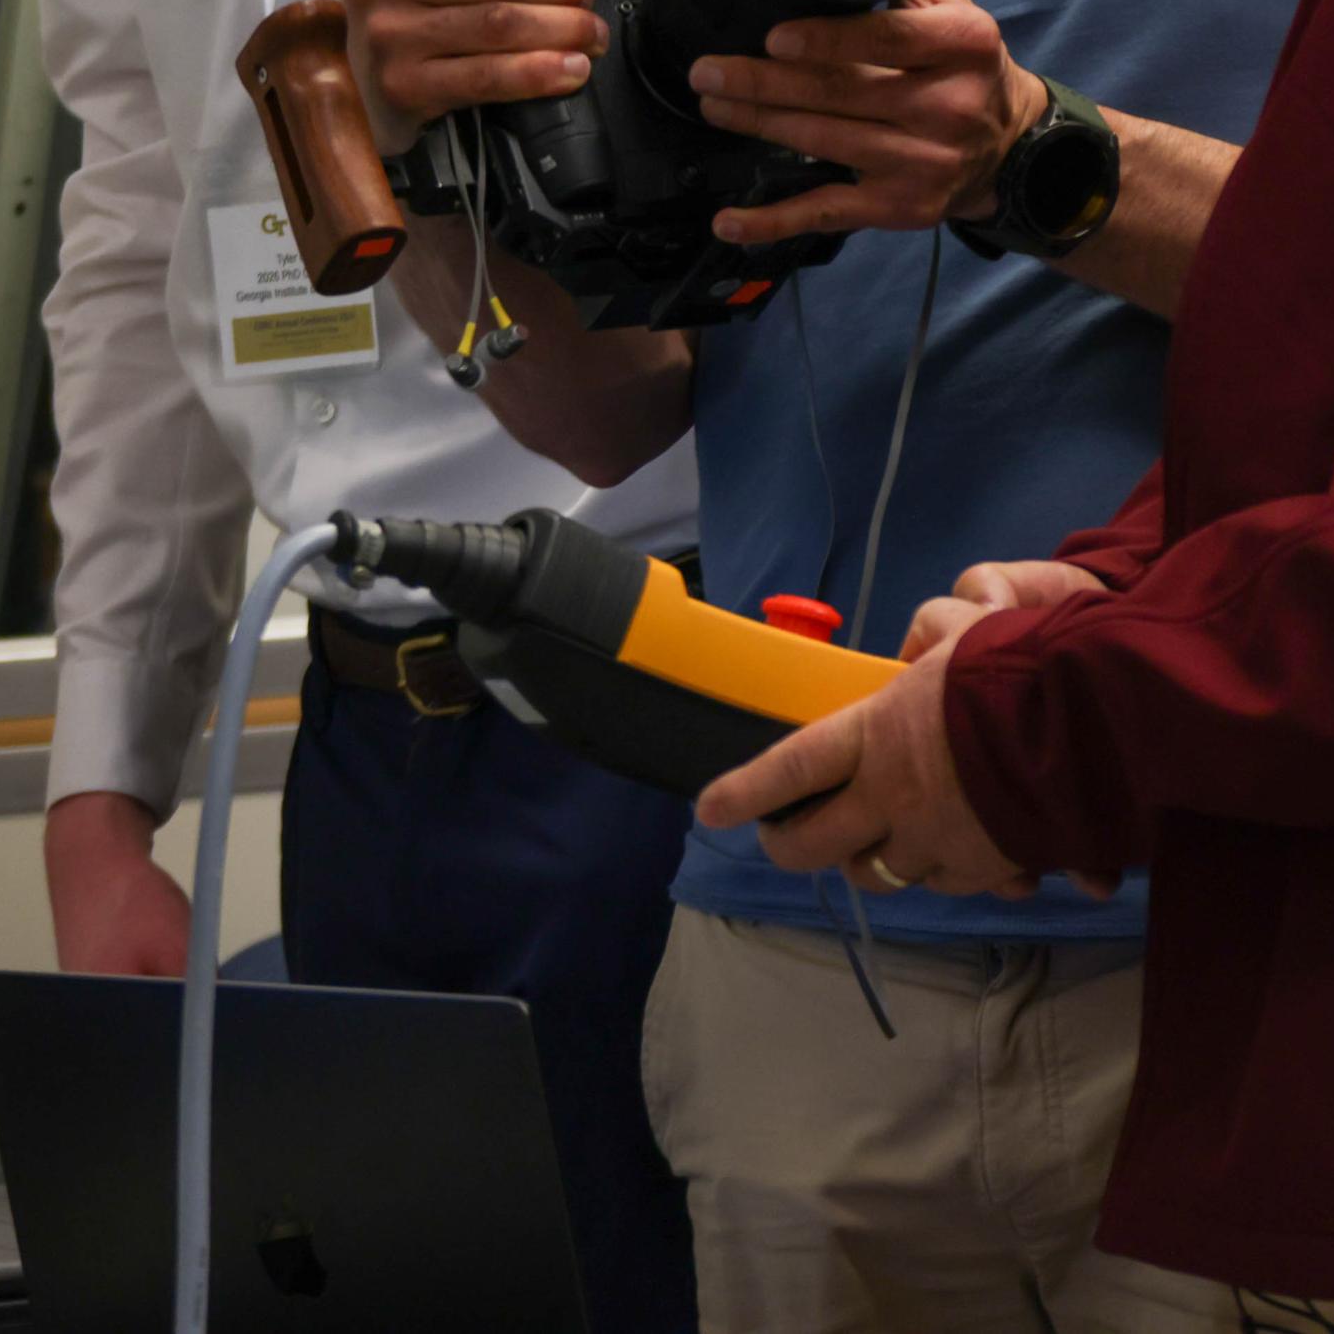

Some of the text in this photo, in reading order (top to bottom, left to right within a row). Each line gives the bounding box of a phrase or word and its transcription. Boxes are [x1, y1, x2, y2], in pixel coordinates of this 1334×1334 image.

[277, 253, 298, 267] Tyler
[236, 286, 308, 303] Georgia Institute
